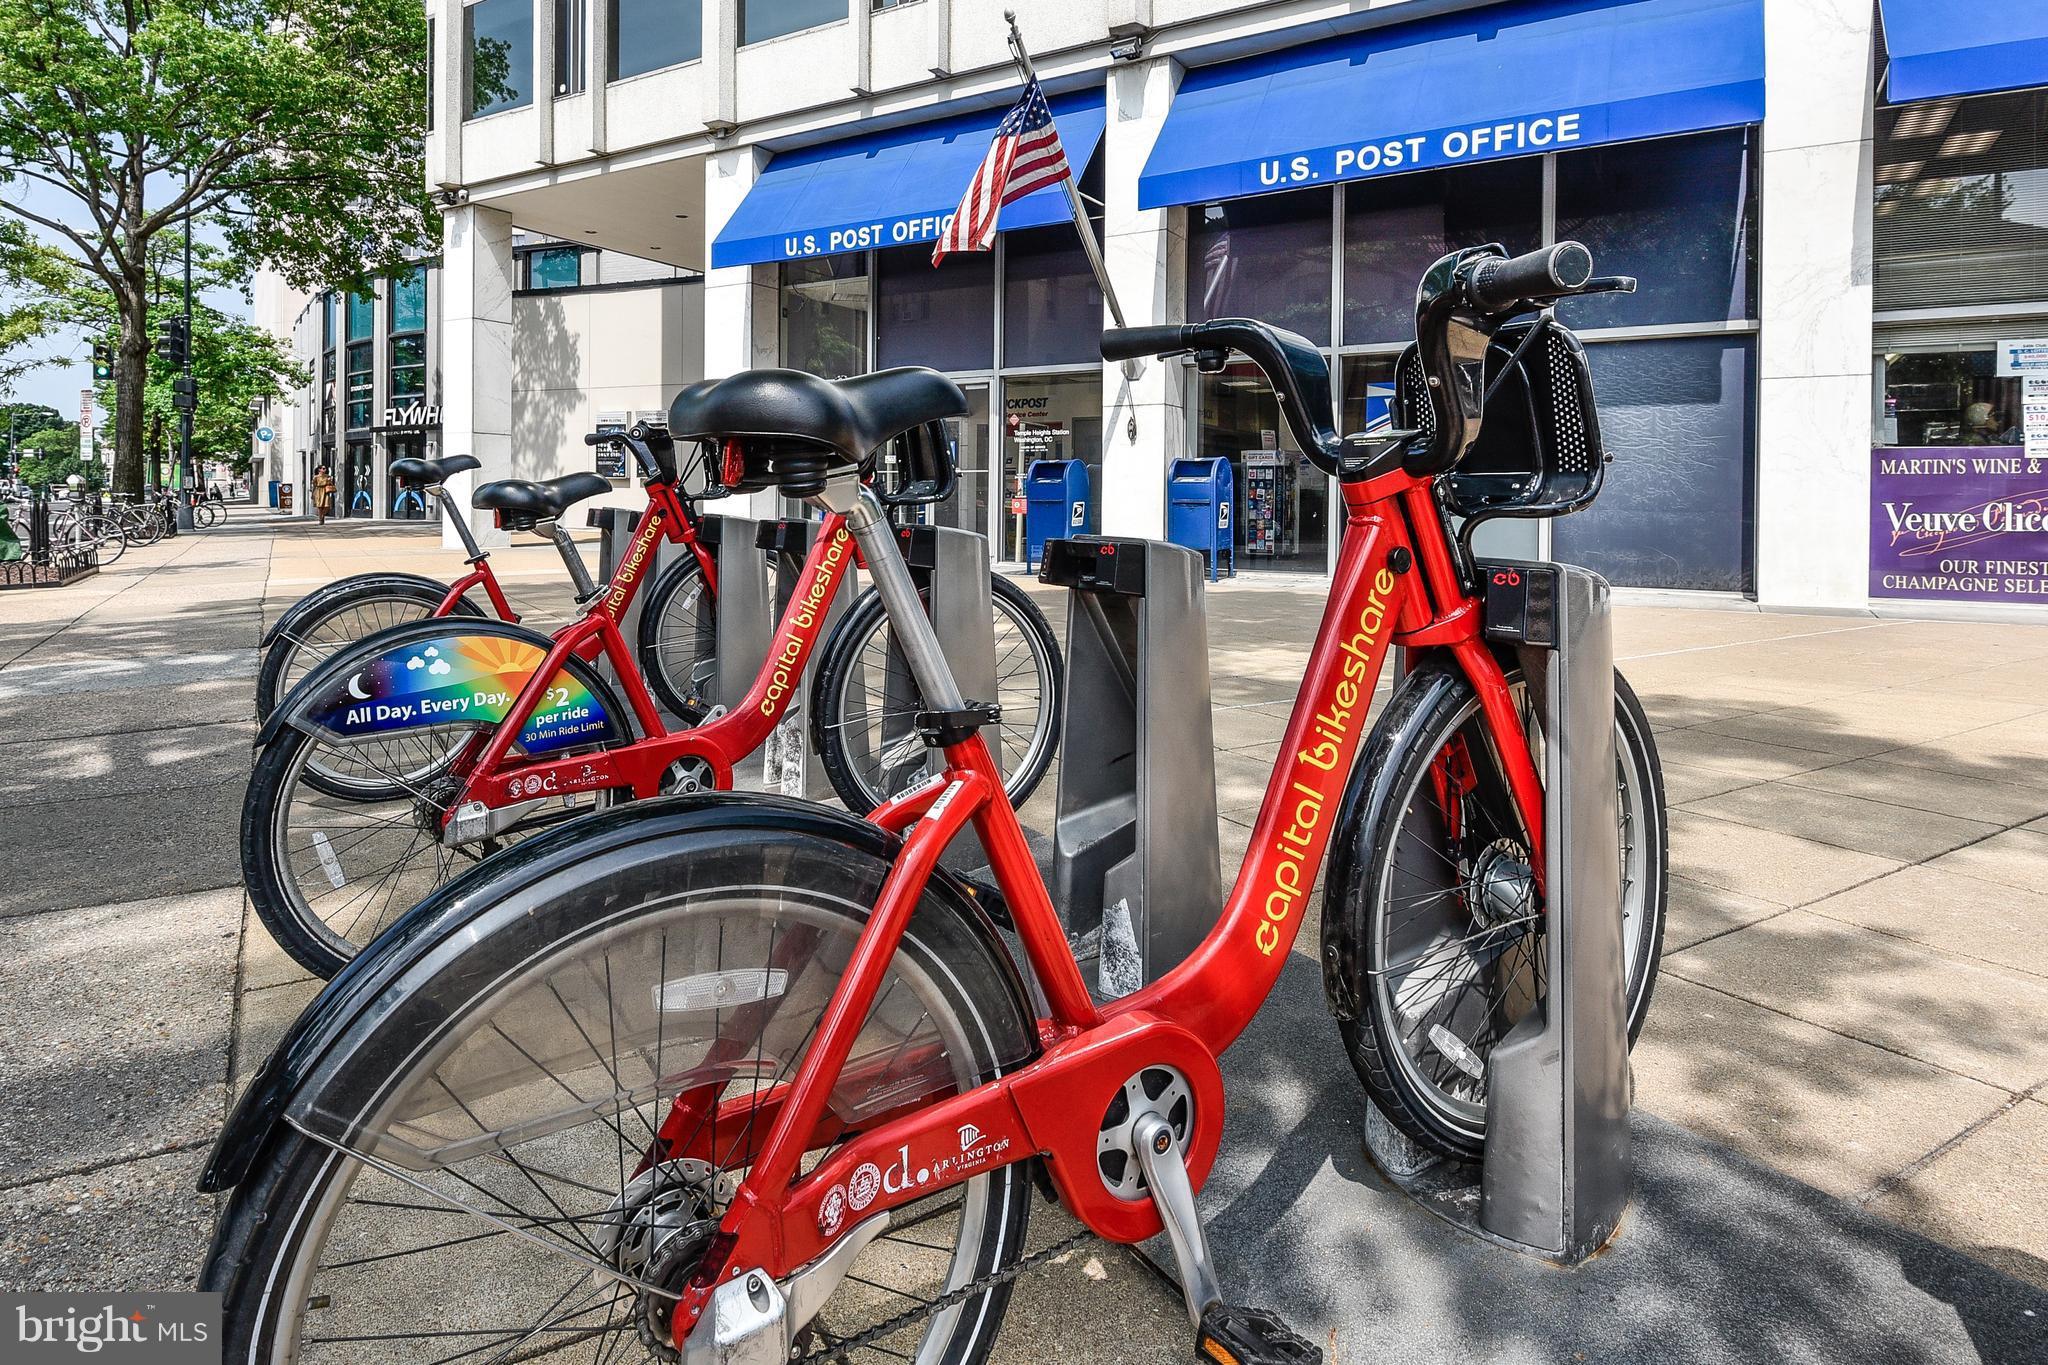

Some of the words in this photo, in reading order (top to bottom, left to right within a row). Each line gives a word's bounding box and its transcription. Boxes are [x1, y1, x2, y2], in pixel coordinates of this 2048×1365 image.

[1259, 156, 1318, 185] U.S.
[1335, 137, 1426, 175] POST
[1442, 113, 1580, 158] OFFICE
[785, 235, 821, 256] U.S.
[830, 224, 883, 251] POST
[892, 215, 954, 242] OFFIC
[1006, 397, 1048, 409] CKPOST
[1880, 458, 1966, 475] MARTIN'S
[1971, 458, 2022, 474] WINE
[2027, 458, 2042, 474] &
[1882, 502, 1977, 532] Veuve
[616, 515, 662, 583] bikeshare
[1939, 559, 1979, 574] OUR
[1985, 560, 2048, 575] FINEST
[1882, 575, 1999, 592] CHAMPAGNE
[760, 633, 804, 717] capital
[789, 527, 849, 629] bikeshare
[346, 707, 371, 725] All
[376, 705, 417, 721] Day.
[421, 697, 470, 714] Every
[473, 692, 511, 707] Day.
[546, 687, 570, 707] $2
[536, 712, 559, 728] per
[562, 706, 589, 721] ride
[525, 732, 537, 742] 30
[539, 729, 557, 739] Min
[558, 724, 579, 736] Ride
[581, 720, 604, 732] Limit
[1255, 781, 1324, 957] capital
[1297, 567, 1396, 772] bikeshare
